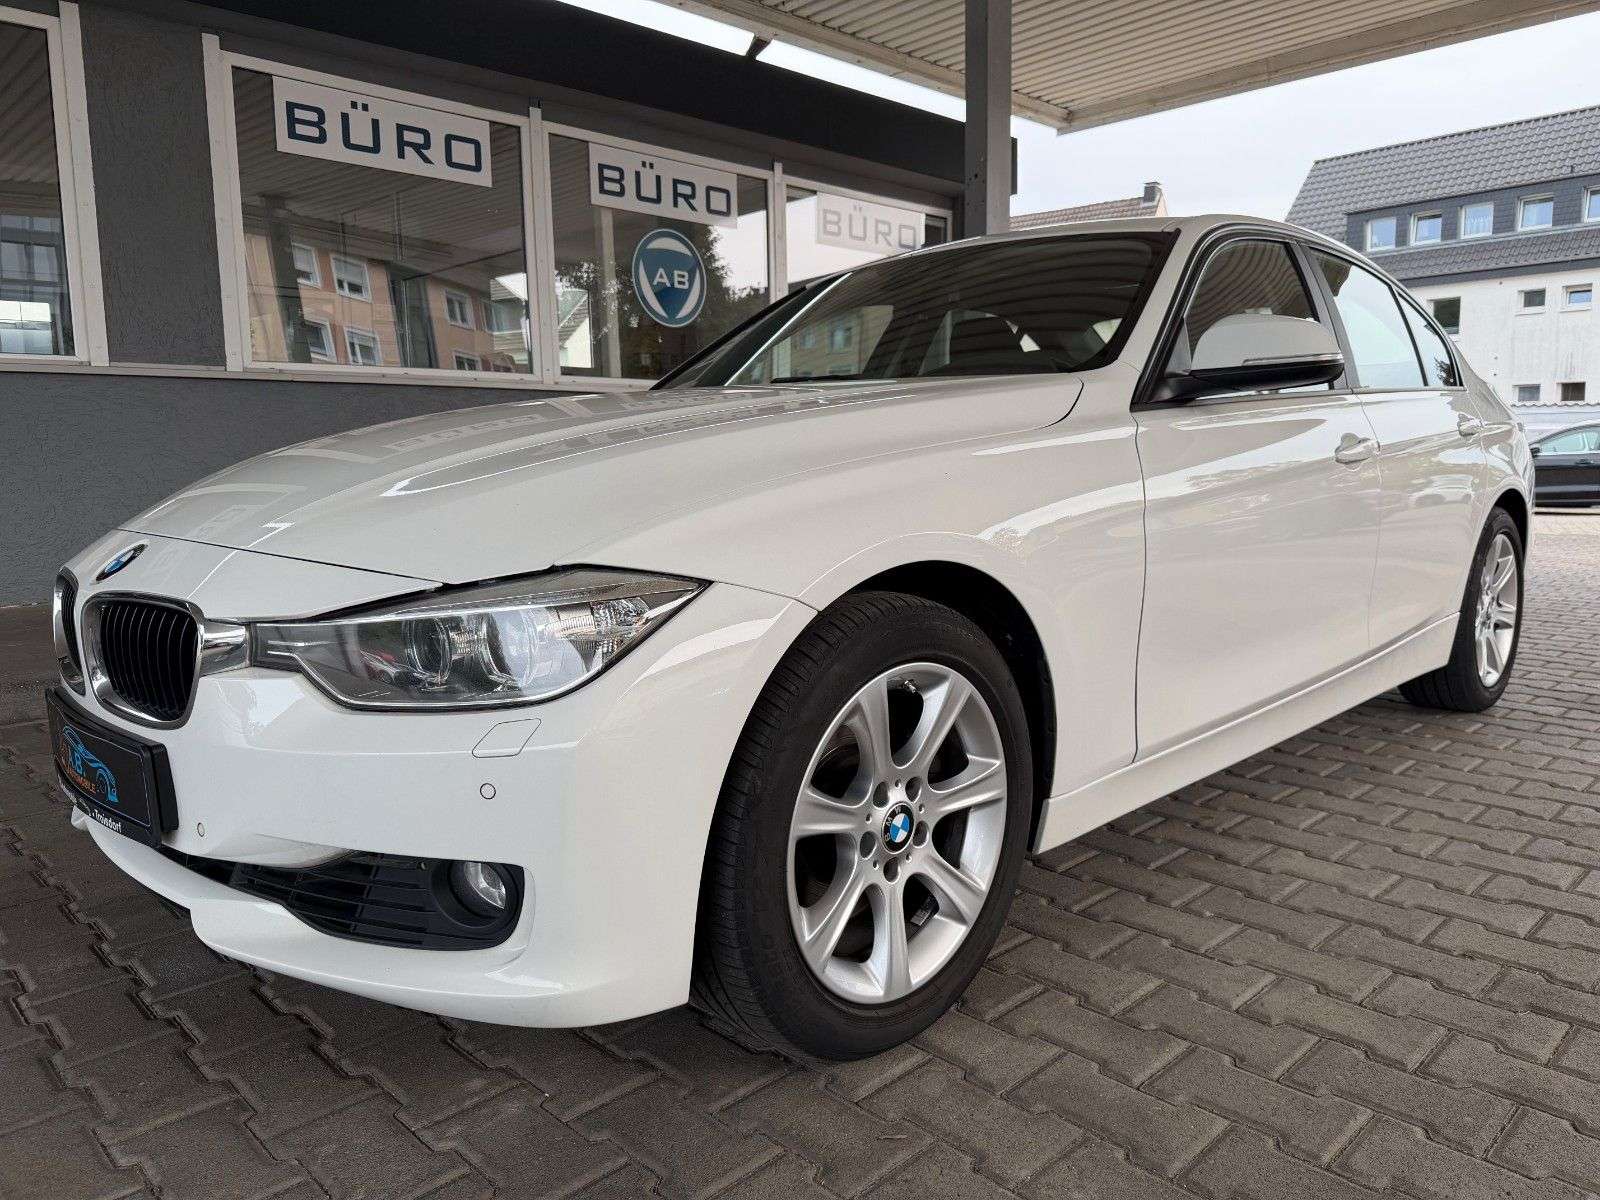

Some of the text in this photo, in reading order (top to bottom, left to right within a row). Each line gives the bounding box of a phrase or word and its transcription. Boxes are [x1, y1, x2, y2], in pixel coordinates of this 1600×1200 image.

[285, 100, 483, 173] BÜRO
[597, 160, 731, 217] BÜRO
[822, 204, 917, 251] BÜRO
[652, 267, 690, 290] AB
[884, 806, 902, 842] BMW
